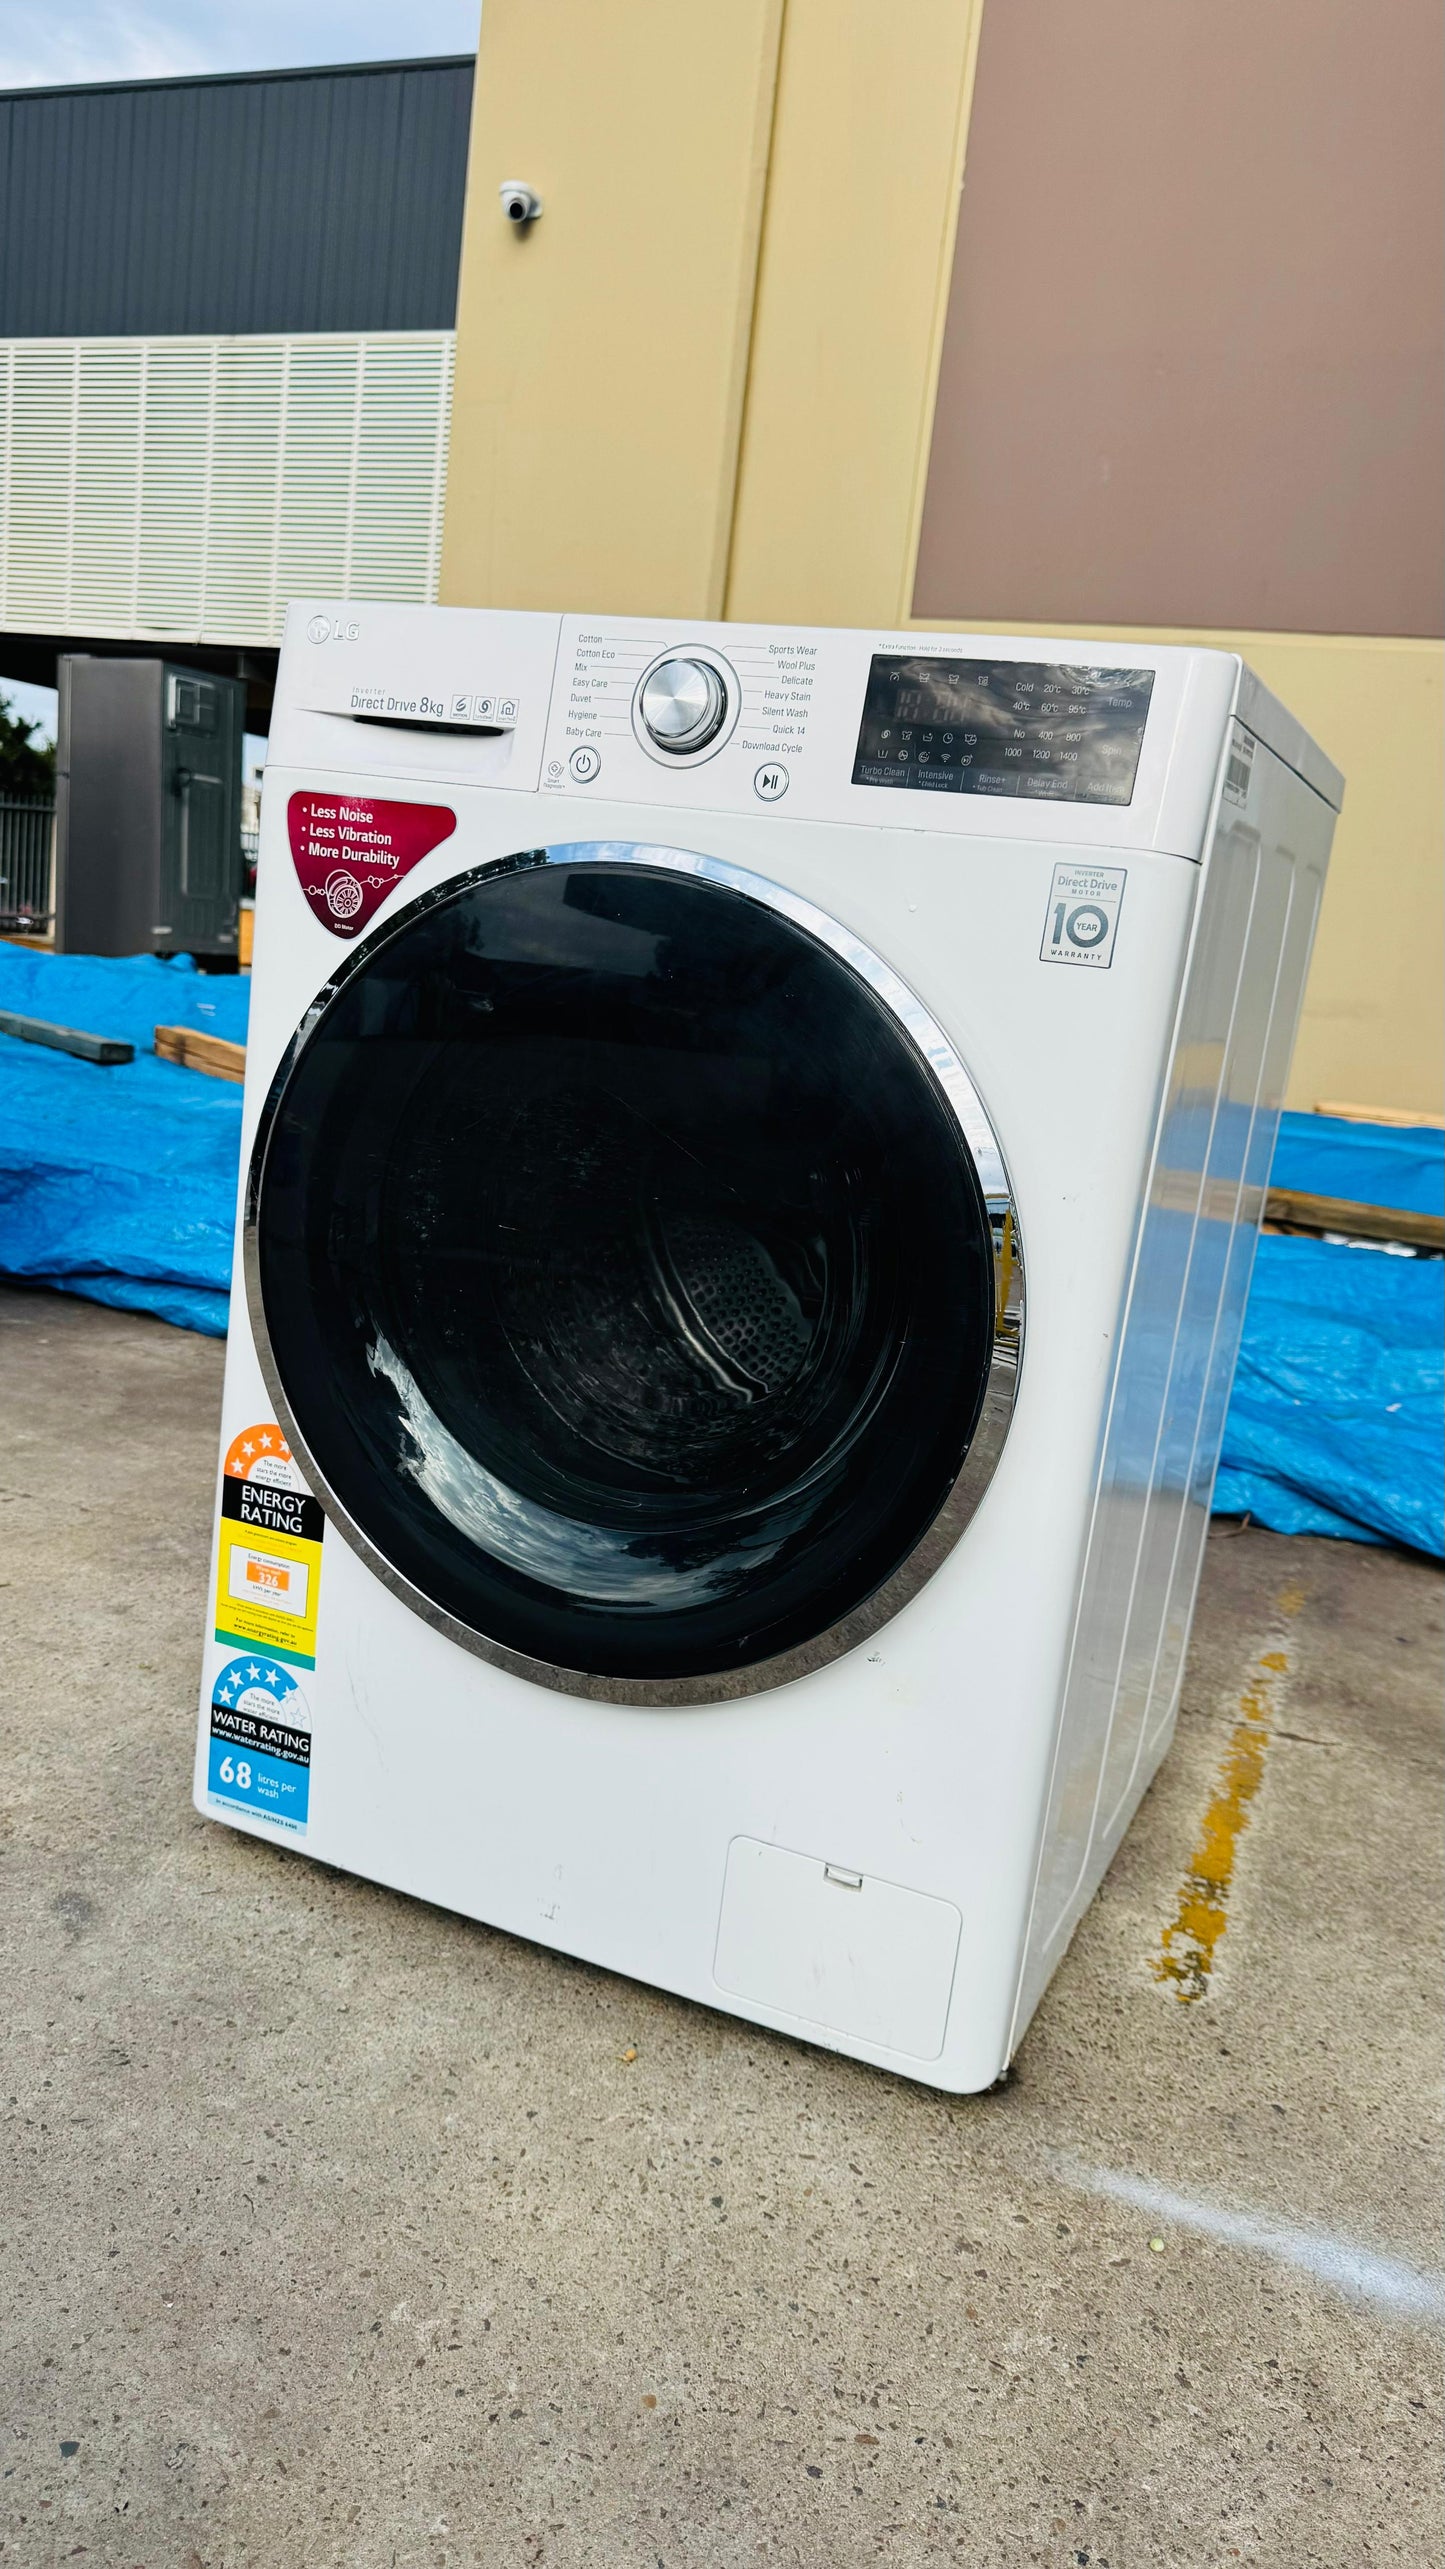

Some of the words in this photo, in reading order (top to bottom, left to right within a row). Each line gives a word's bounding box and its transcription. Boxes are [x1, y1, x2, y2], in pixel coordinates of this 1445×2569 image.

[333, 620, 360, 641] LG
[578, 634, 603, 644] Cotton
[576, 648, 601, 658] Cotton
[602, 650, 616, 659] Eco
[768, 644, 794, 655] Sports
[796, 645, 818, 655] Wear
[574, 663, 588, 671] Mix
[777, 660, 798, 670] Wool
[799, 661, 816, 671] Plus
[572, 678, 590, 688] Easy
[591, 679, 608, 688] Care
[781, 675, 814, 686] Delicate
[352, 686, 386, 695] Inverter
[1015, 682, 1034, 692] Cold
[570, 693, 592, 703] Duvet
[764, 690, 789, 701] Heavy
[790, 691, 811, 701] Stain
[351, 695, 384, 710] Direct
[387, 697, 417, 713] Drive
[419, 697, 444, 717] 8kg
[1108, 697, 1133, 709] Temp
[568, 710, 598, 721] Hygiene
[761, 706, 784, 717] Silent
[786, 708, 809, 718] Wash
[565, 727, 584, 738] Baby
[585, 728, 602, 738] Care
[772, 724, 794, 735] Quick
[797, 726, 806, 735] 14
[1013, 729, 1026, 739] No
[1038, 730, 1053, 741] 400
[1065, 732, 1082, 742] 800
[742, 740, 780, 752] Download
[781, 743, 803, 754] Cycle
[1102, 744, 1122, 757] Spin
[1004, 747, 1022, 757] 1000
[1032, 749, 1051, 760] 1200
[1060, 751, 1078, 761] 1400
[860, 765, 883, 775] Turbo
[883, 766, 906, 777] Clean
[918, 769, 954, 780] Intensive
[1027, 777, 1050, 788] Delay
[1051, 779, 1069, 789] End
[1087, 782, 1105, 791] Add
[310, 803, 336, 820] Less
[339, 807, 374, 824] Noise
[309, 822, 335, 839] Less
[338, 826, 392, 845] Vibration
[308, 842, 339, 859] More
[342, 846, 400, 870] Durability
[1074, 870, 1104, 878] INVERTER
[1057, 876, 1088, 888] Direct
[1090, 879, 1118, 891] Drive
[1071, 888, 1101, 897] MOTOR
[1052, 902, 1109, 948] 10
[1076, 922, 1098, 932] YEAR
[1050, 949, 1102, 960] WARRANTY
[263, 1459, 273, 1467] The
[255, 1474, 271, 1483] energy
[241, 1484, 306, 1515] ENERGY
[240, 1503, 303, 1534] RATING
[258, 1571, 279, 1587] 326
[250, 1692, 259, 1700] The
[261, 1698, 275, 1706] more
[266, 1707, 280, 1715] more
[212, 1709, 257, 1736] WATER
[260, 1724, 310, 1752] RATING
[211, 1726, 310, 1764] www.waterrating.gov.au
[219, 1756, 252, 1790] 68
[257, 1772, 279, 1788] litres
[281, 1783, 297, 1795] per
[257, 1785, 279, 1799] wash
